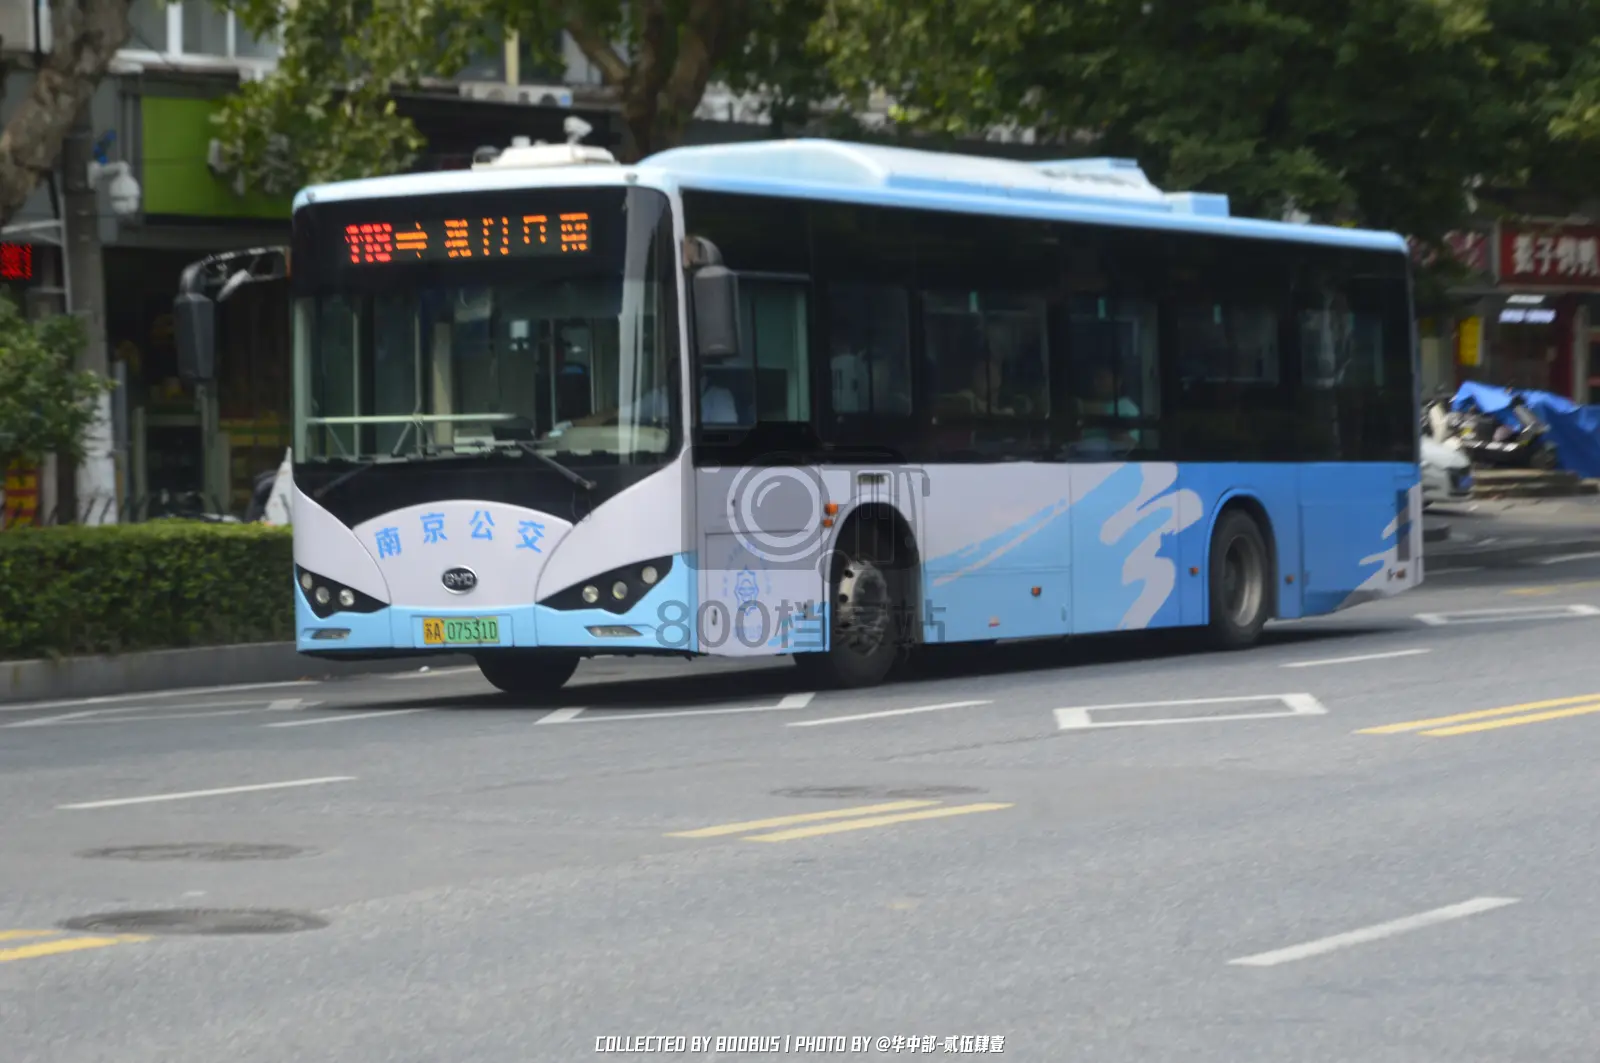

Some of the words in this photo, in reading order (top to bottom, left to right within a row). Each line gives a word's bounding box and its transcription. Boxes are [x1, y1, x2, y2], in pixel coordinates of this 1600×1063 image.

[374, 510, 546, 559] 南京公交
[444, 571, 475, 588] BYD
